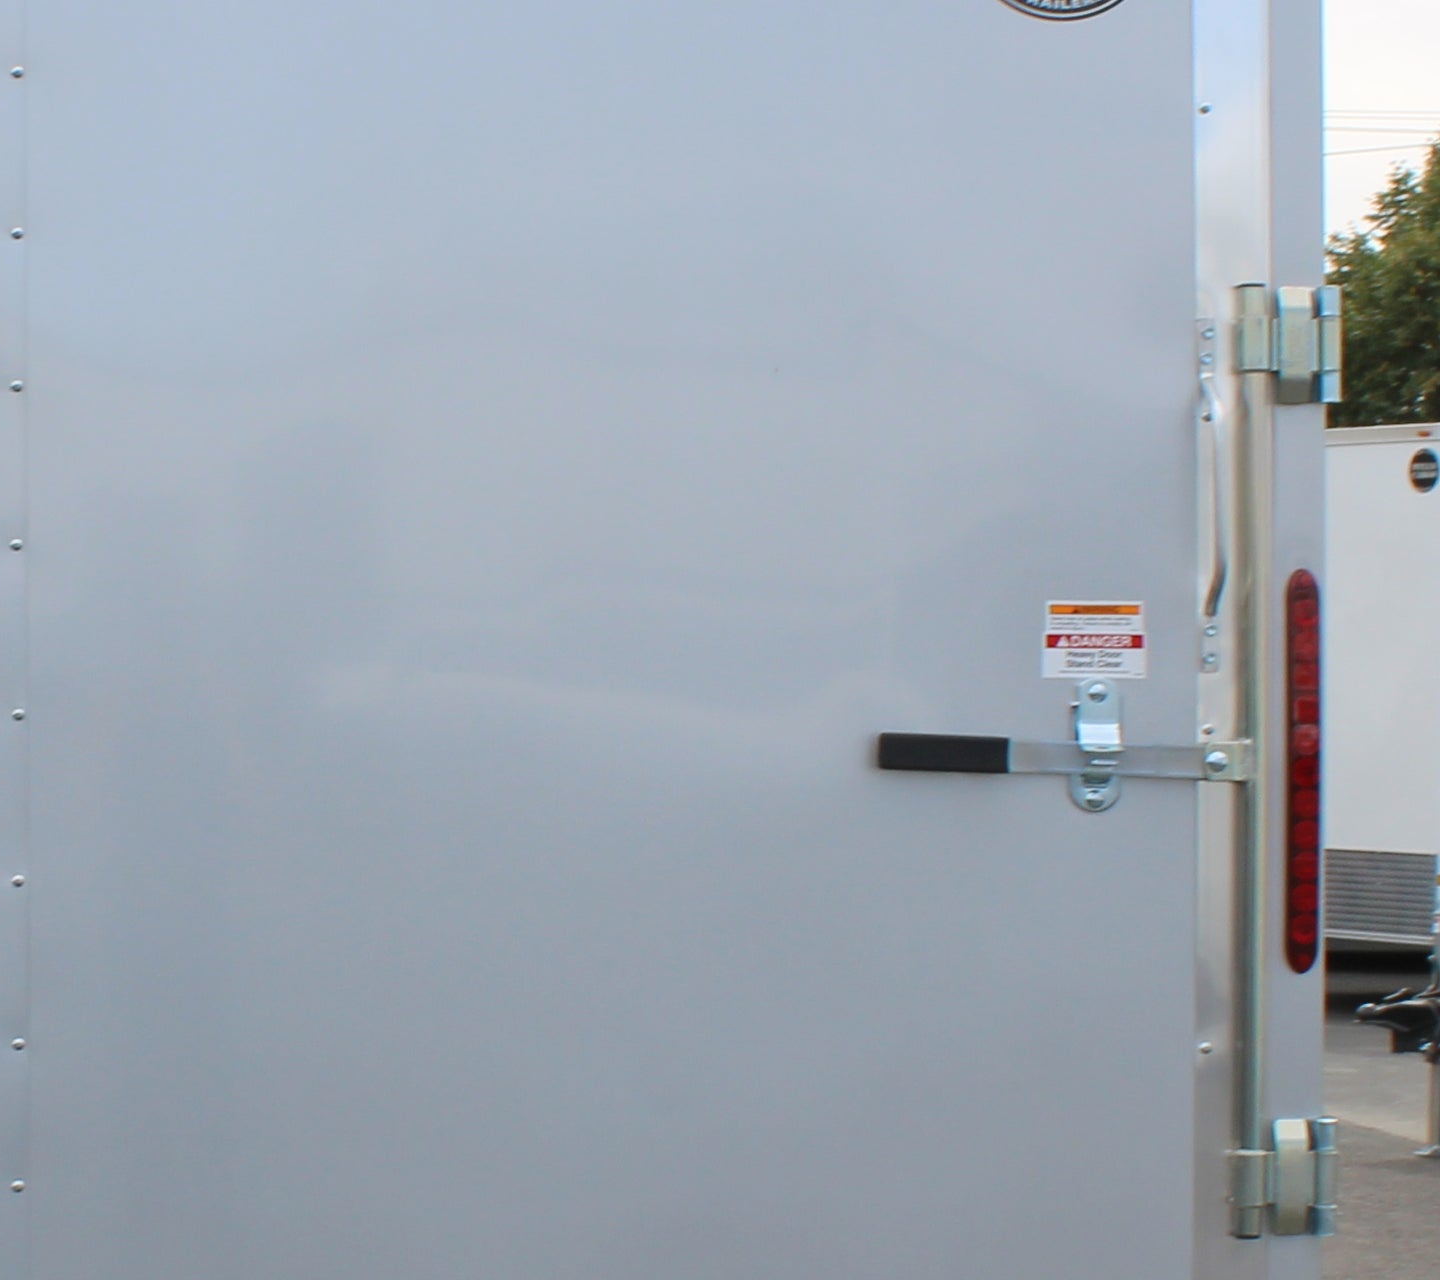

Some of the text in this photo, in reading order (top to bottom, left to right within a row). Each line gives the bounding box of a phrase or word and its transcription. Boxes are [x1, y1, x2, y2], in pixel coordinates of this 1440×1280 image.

[1070, 635, 1133, 648] DANGER
[1066, 650, 1122, 661] Heavy Door
[1066, 659, 1123, 668] Stand Clear
